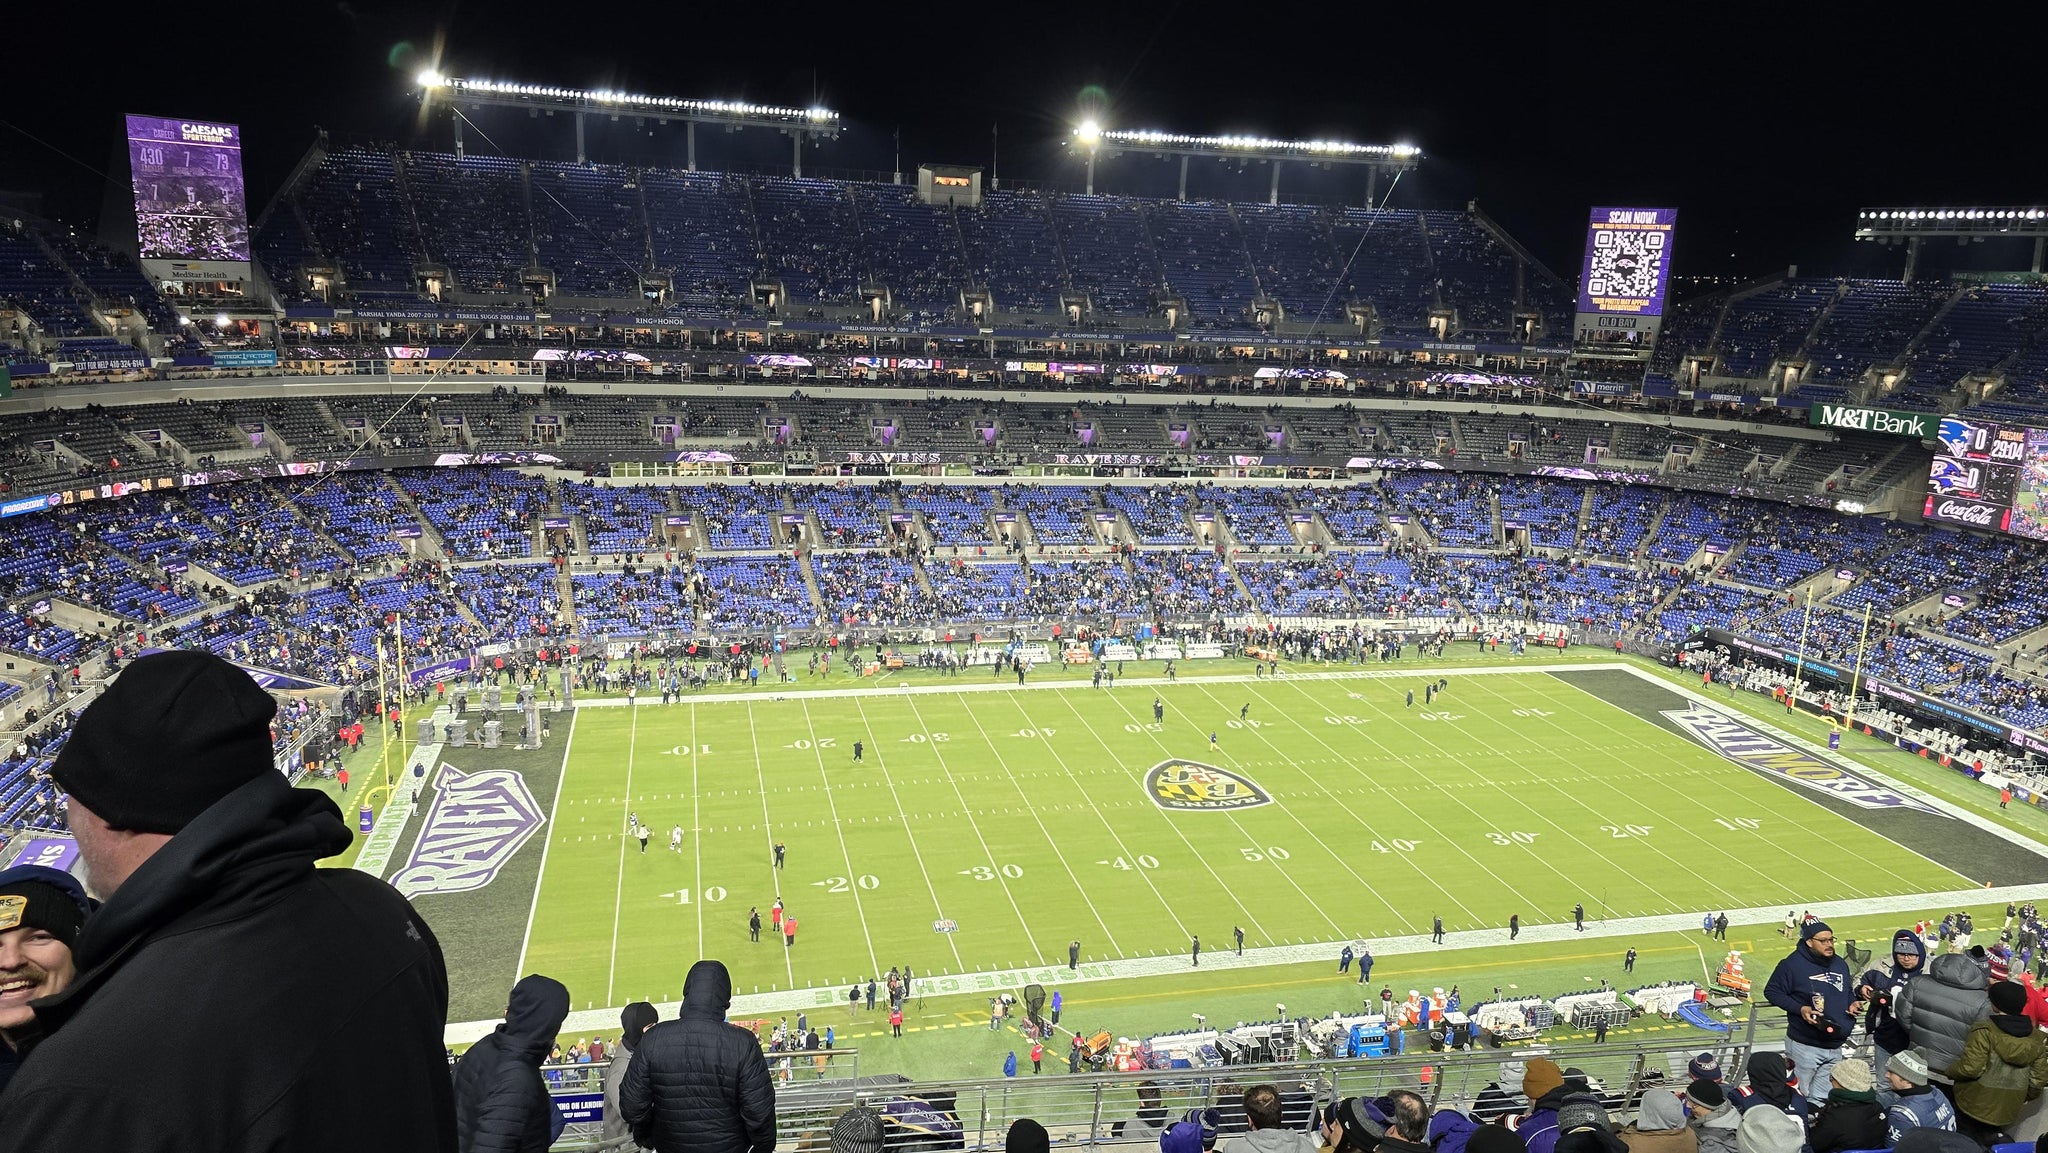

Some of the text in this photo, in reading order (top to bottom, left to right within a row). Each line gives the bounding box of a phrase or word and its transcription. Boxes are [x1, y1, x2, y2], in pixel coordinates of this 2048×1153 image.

[181, 123, 233, 137] CAESARS
[182, 133, 224, 143] SPORTSBOOK
[140, 147, 229, 170] 430 7 73
[1608, 210, 1658, 225] SCAN NOW!
[383, 311, 407, 319] YANDA
[480, 313, 499, 321] SUGGS
[635, 317, 653, 325] RING
[658, 318, 684, 326] HONOR
[1600, 317, 1635, 328] OLD BAY
[1062, 331, 1072, 339] AFC
[75, 362, 87, 371] TEXT
[87, 361, 98, 370] FOR
[97, 360, 109, 370] HELP
[1597, 384, 1625, 392] merritt
[1820, 405, 1925, 437] M&T Bank
[1974, 428, 2025, 450] 0 PREGAME
[1991, 439, 2024, 461] 29:04
[848, 452, 941, 464] RAVENS
[1055, 454, 1142, 465] RAVENS
[157, 477, 174, 489] FINAL
[1967, 467, 1980, 489] 0
[62, 489, 96, 505] 23 FINAL
[101, 484, 113, 499] 20
[1, 498, 47, 515] PROGRESSIVE
[1937, 499, 1997, 526] Coca-Cola
[1732, 637, 1753, 649] Better
[1805, 661, 1840, 678] outcomes.
[1419, 710, 1459, 722] 20
[1511, 707, 1549, 719] 10
[1922, 701, 1944, 713] INVEST
[1944, 708, 1962, 719] WITH
[1124, 722, 1165, 734] 50
[1225, 718, 1262, 730] 40
[1323, 714, 1365, 727] 30
[908, 732, 951, 744] 30
[1019, 726, 1058, 739] 40
[671, 743, 713, 756] 10
[794, 737, 838, 750] 20
[1682, 710, 1906, 806] BALTIMORE
[1169, 796, 1261, 808] RAVENS
[396, 768, 538, 894] RAVENS
[1599, 822, 1649, 839] 20
[1712, 816, 1757, 832] 10
[359, 800, 411, 868] STOP HATE
[1484, 830, 1535, 847] 30
[1369, 837, 1416, 854] 40
[1239, 846, 1290, 863] 50
[1111, 854, 1160, 871] 40
[970, 863, 1025, 882] 30
[825, 873, 880, 894] 20
[674, 885, 728, 906] 10
[815, 964, 1115, 1005] INSPIRE CHNGE
[571, 1102, 580, 1110] ON
[580, 1100, 605, 1110] LANDIN
